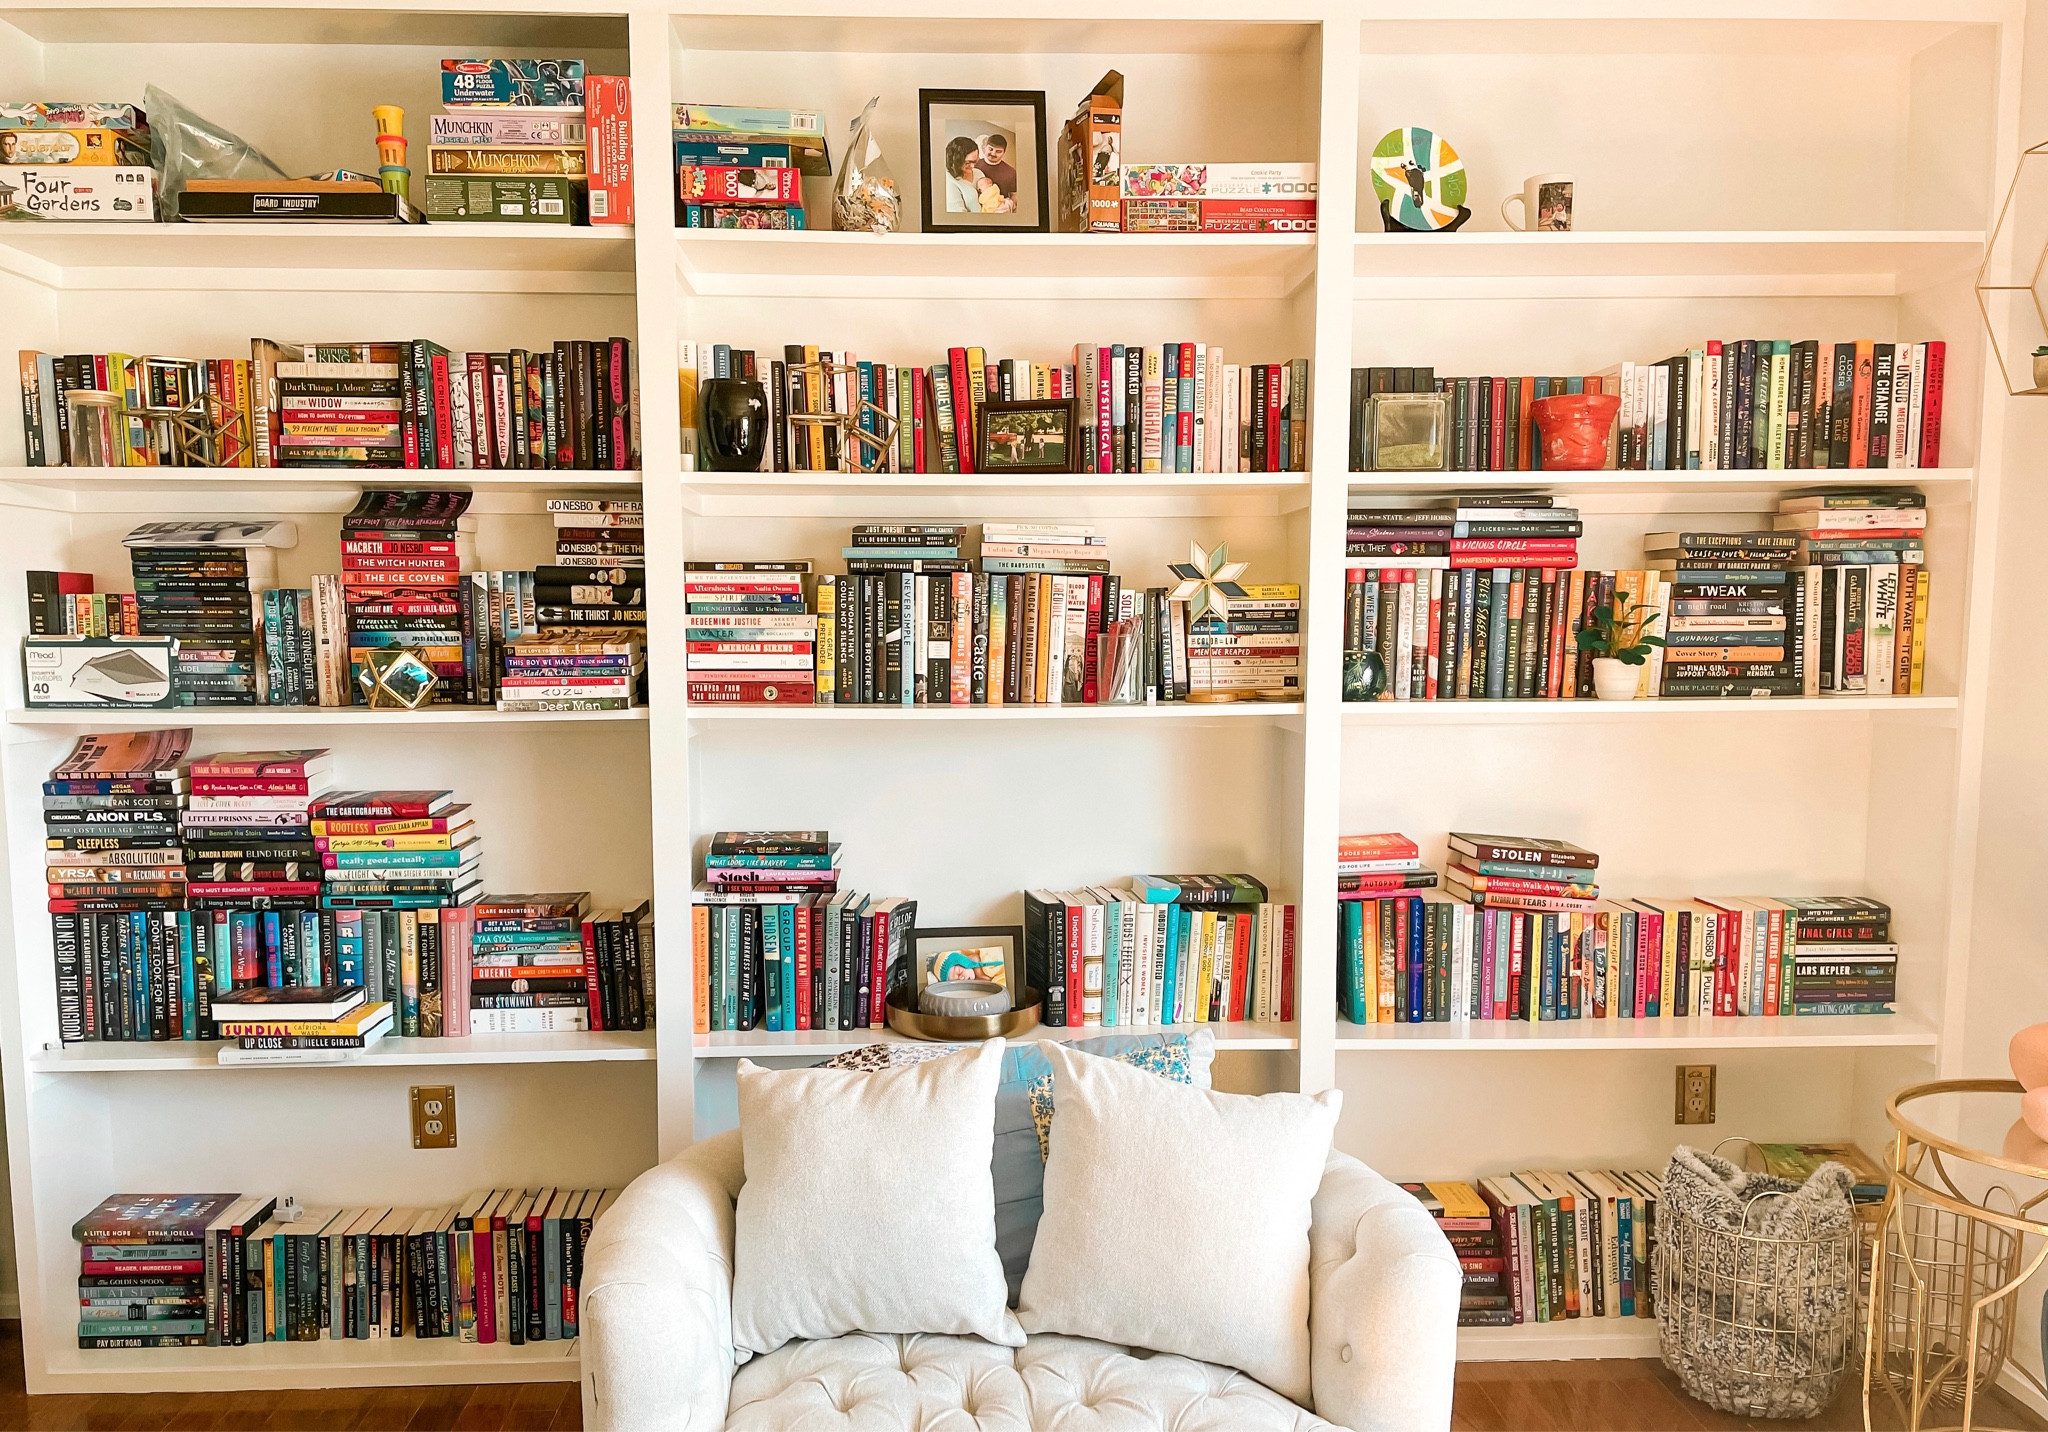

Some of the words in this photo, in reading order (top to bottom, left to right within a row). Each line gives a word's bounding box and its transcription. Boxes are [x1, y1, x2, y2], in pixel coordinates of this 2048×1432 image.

[454, 75, 474, 88] 48
[435, 119, 493, 135] MUNCHKIN
[619, 121, 627, 161] Building
[466, 151, 540, 168] MUNCHKIN
[22, 172, 71, 194] Four
[726, 170, 737, 197] 1000
[27, 195, 100, 212] Gardens
[256, 197, 278, 208] BOARD
[282, 198, 317, 208] INDUSTRY
[319, 354, 349, 362] KING
[1838, 355, 1846, 387] CLOSER
[1878, 355, 1891, 376] THE
[1128, 353, 1139, 395] SPOOKED
[285, 383, 306, 391] Dark
[308, 384, 333, 392] Things
[1896, 365, 1909, 403] UNSUB
[309, 399, 342, 408] WIDOW
[1164, 378, 1177, 417] RITUAL
[1875, 378, 1889, 425] CHANGE
[1100, 380, 1109, 457] HYSTERICAL
[1898, 408, 1906, 419] MEG
[1895, 421, 1905, 459] GARDINER
[347, 542, 382, 553] MACBETH
[1463, 541, 1495, 550] VICIOUS
[1497, 541, 1527, 550] CIRCLE
[1709, 537, 1742, 545] EXCEPTIONS
[1758, 538, 1770, 546] KATE
[1772, 538, 1796, 546] ZERNIKE
[365, 574, 385, 582] THE
[1905, 569, 1914, 598] RUTH
[1698, 586, 1746, 596] TWEAK
[1887, 572, 1896, 612] LETHAL
[1417, 579, 1428, 631] DOPESICK
[1877, 579, 1888, 619] WHITE
[570, 610, 583, 620] THE
[585, 610, 609, 620] THIRST
[691, 618, 732, 626] REDEEMING
[1903, 600, 1914, 632] WARE
[700, 630, 734, 638] WATER
[974, 635, 986, 681] Caste
[1697, 650, 1718, 658] Story
[1902, 646, 1909, 656] IT
[302, 630, 314, 691] STONECUTTER
[1900, 657, 1909, 679] GIRL
[32, 684, 49, 694] 40
[538, 701, 569, 711] Deer
[572, 701, 601, 711] Man
[86, 813, 129, 821] ANON
[134, 813, 166, 821] PLS.
[326, 807, 337, 815] THE
[340, 807, 392, 816] CARTOGRAPHERS
[331, 823, 369, 833] ROOTLESS
[77, 839, 119, 849] SLEEPLESS
[109, 853, 165, 864] ABSOLUTION
[246, 849, 270, 858] BLIND
[273, 849, 298, 858] TIGER
[392, 855, 426, 865] actually
[1492, 849, 1541, 862] STOLEN
[58, 869, 95, 878] YRSA
[56, 916, 74, 930] JO
[798, 911, 807, 930] THE
[151, 920, 160, 948] DON'T
[782, 910, 791, 952] GROUP
[1071, 916, 1079, 947] Undoing
[798, 932, 807, 947] KEY
[152, 950, 162, 979] LOOK
[799, 952, 807, 975] MAN
[480, 968, 512, 978] QUEENIE
[1797, 966, 1817, 975] LARS
[1820, 966, 1850, 976] KEPLER
[60, 975, 77, 992] THE
[61, 995, 84, 1042] KINGDOM
[156, 1003, 163, 1020] ME
[225, 1025, 291, 1035] SUNDIAL
[245, 1038, 255, 1048] UP
[258, 1038, 282, 1048] CLOSE
[1611, 1236, 1619, 1284] Educated
[97, 1338, 108, 1347] PAY
[110, 1339, 123, 1347] DIRT
[126, 1339, 141, 1347] ROAD
